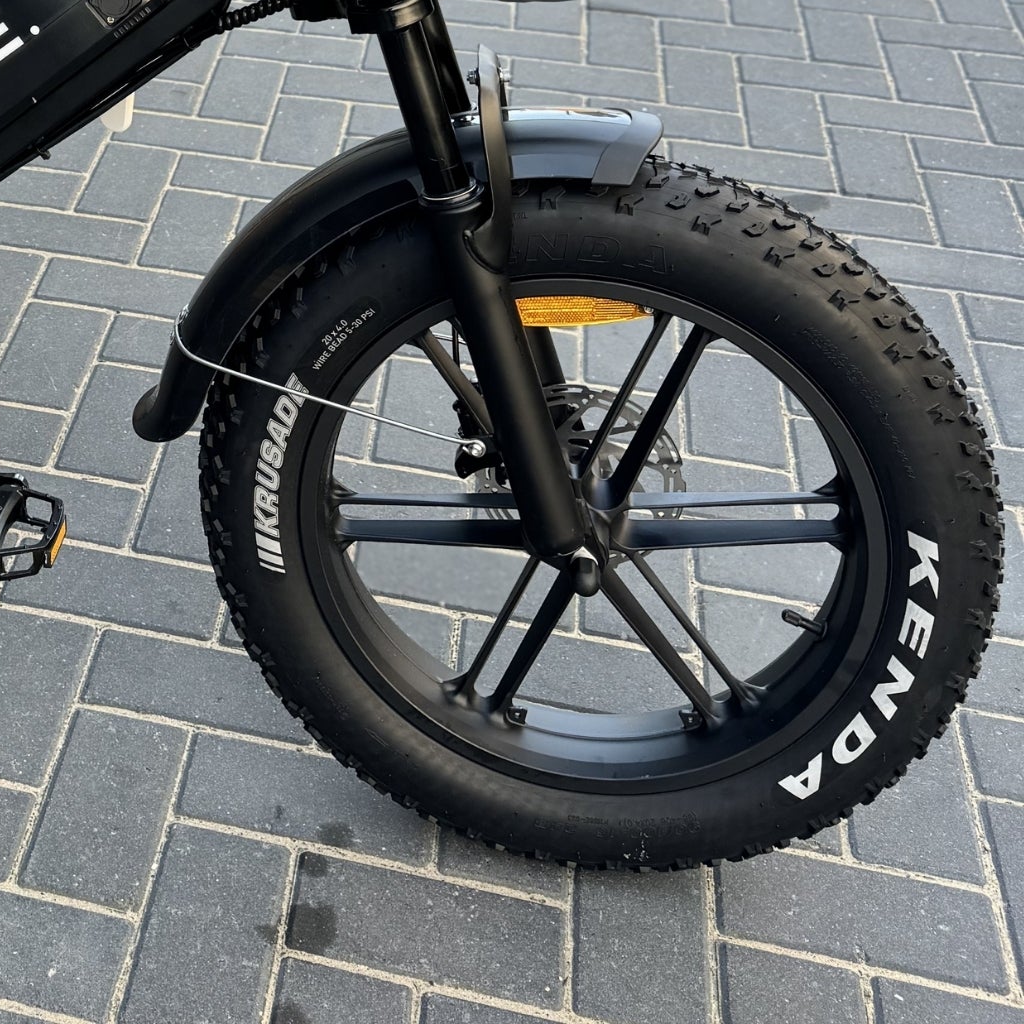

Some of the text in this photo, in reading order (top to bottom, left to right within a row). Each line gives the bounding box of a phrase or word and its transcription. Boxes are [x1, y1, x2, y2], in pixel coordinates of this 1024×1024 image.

[508, 232, 670, 275] NDA
[312, 307, 376, 370] WIRE BEAD 5-30 PSI
[321, 334, 333, 346] 20
[335, 319, 348, 332] 4.0
[254, 372, 310, 538] KRUSADE
[778, 530, 940, 800] KENDA
